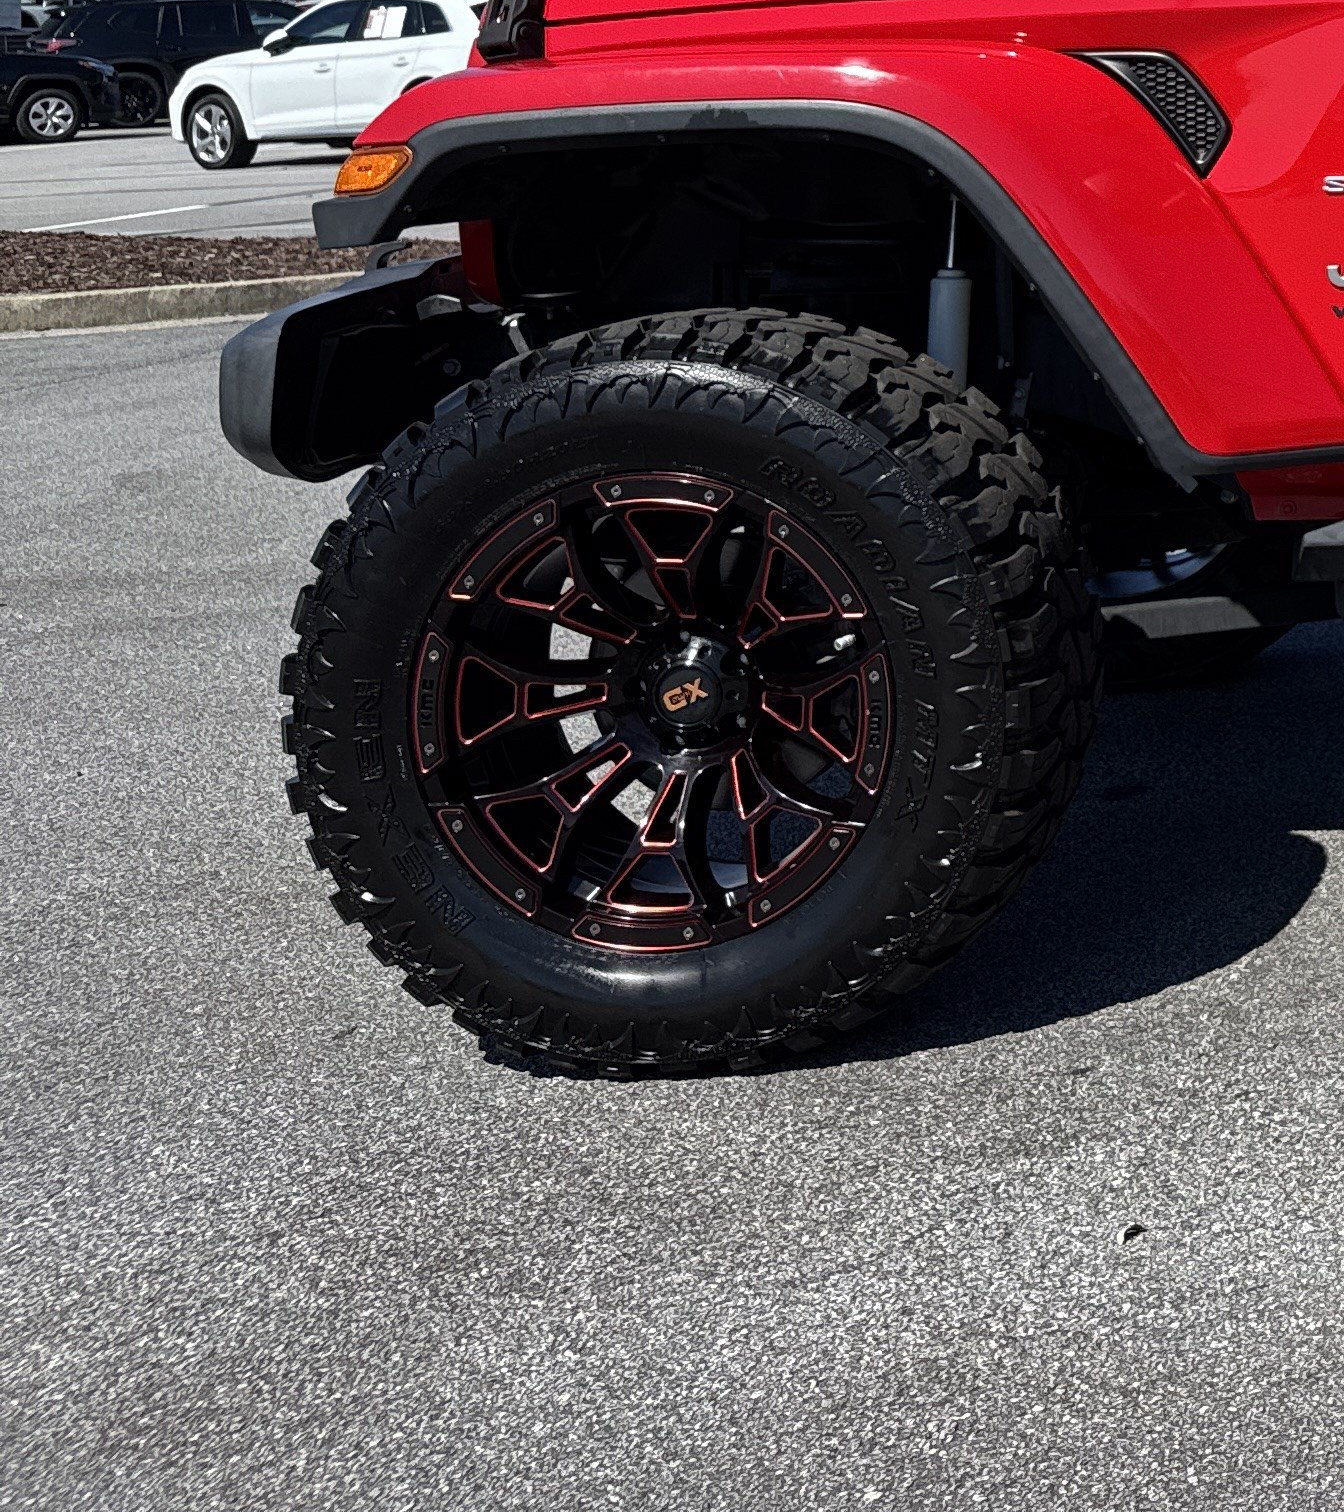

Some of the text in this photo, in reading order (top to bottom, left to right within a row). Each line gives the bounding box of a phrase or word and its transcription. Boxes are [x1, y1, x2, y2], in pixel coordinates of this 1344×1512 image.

[760, 456, 940, 834] ROADIAN MTX
[353, 679, 478, 937] NEXEN
